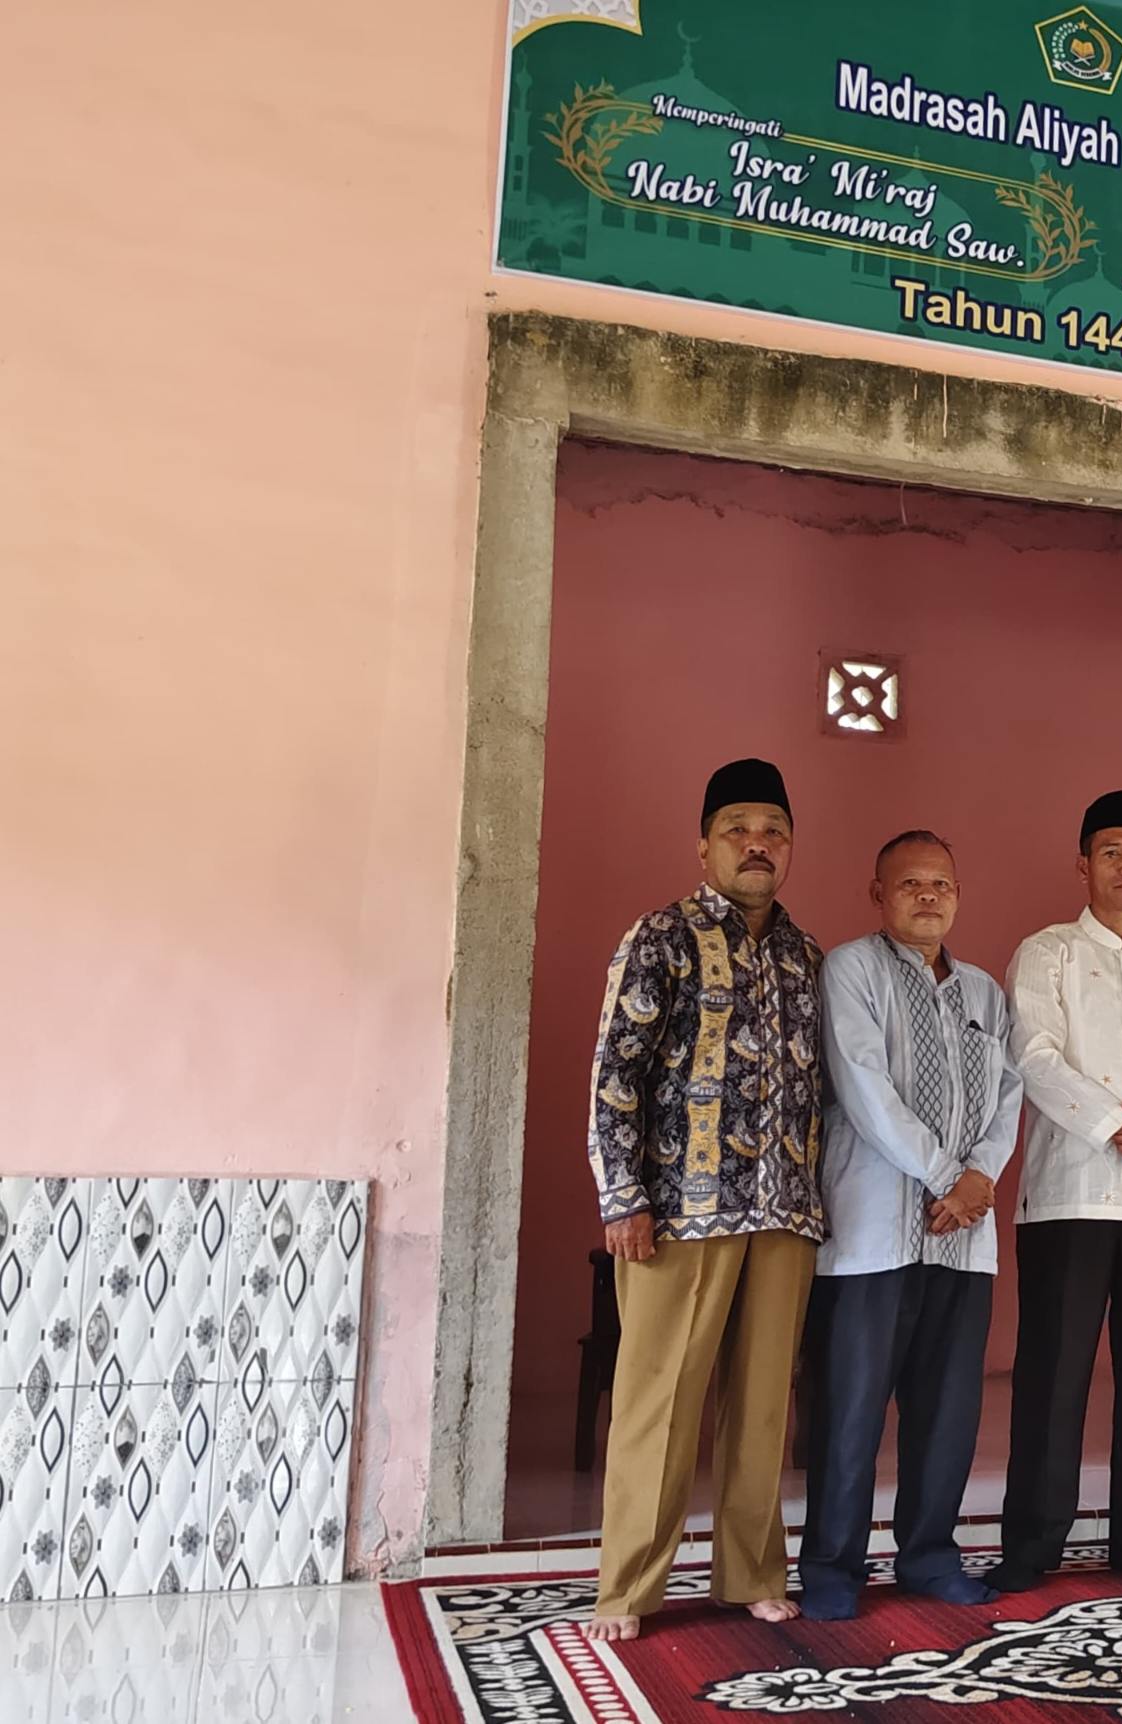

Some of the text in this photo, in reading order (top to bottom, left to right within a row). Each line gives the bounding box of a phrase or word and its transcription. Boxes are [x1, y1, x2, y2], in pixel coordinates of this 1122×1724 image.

[652, 94, 784, 138] Memperingati
[838, 62, 1007, 142] Madrasah
[1016, 102, 1118, 166] Aliyah
[627, 161, 1025, 268] Nabi Muhammad Saw.
[894, 280, 1042, 341] Tahun
